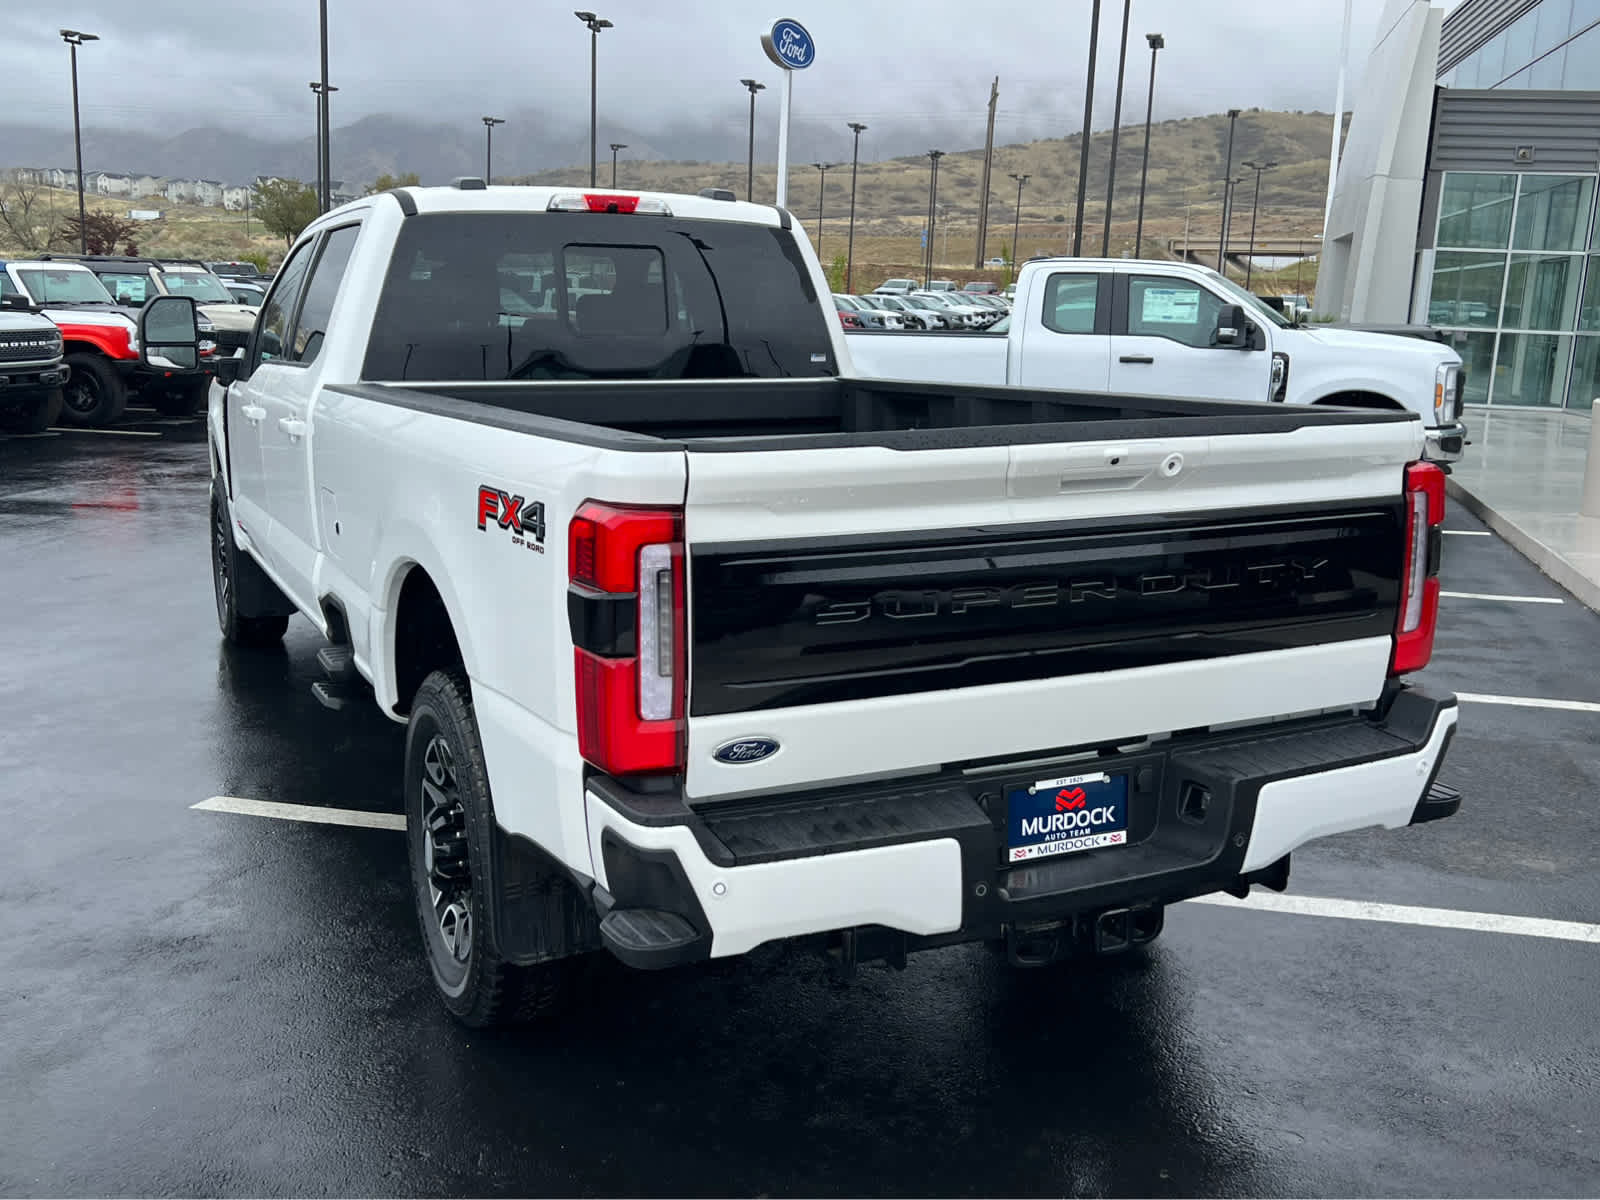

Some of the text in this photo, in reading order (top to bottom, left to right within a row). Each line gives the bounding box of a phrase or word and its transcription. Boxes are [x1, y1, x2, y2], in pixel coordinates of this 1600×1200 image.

[780, 27, 807, 62] Ford
[478, 484, 546, 544] FX4
[512, 536, 545, 555] OFF ROAD
[815, 579, 1118, 625] SUPER
[729, 742, 767, 760] Ford
[1021, 805, 1116, 836] MURDOCK
[1037, 835, 1100, 856] MURDOCK
[1045, 827, 1091, 841] AUTO TEAM
